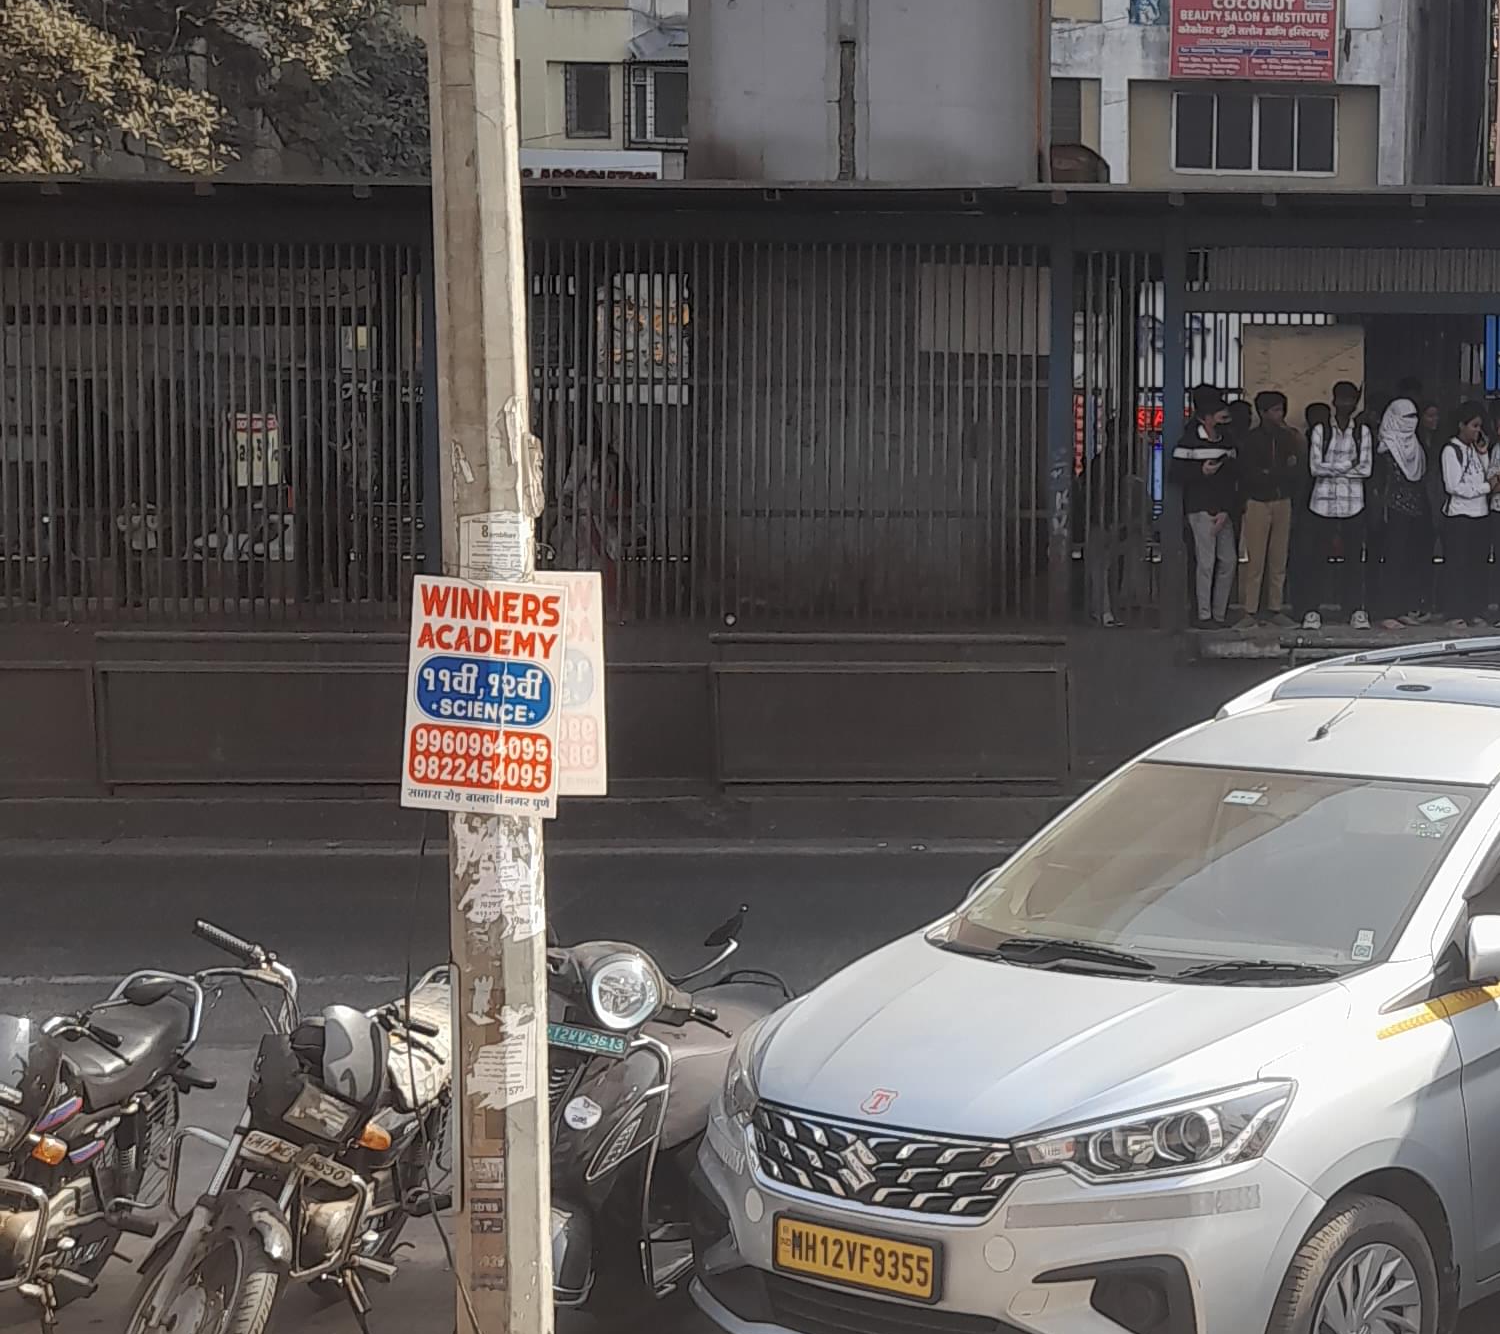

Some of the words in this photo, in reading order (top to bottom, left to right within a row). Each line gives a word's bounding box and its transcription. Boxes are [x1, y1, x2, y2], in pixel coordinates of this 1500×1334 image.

[1180, 10, 1222, 21] BEAUTY
[1224, 11, 1260, 22] SALON
[1272, 12, 1328, 23] INSTITUTE
[420, 584, 561, 627] WINNERS
[417, 623, 558, 659] ACADEMY
[439, 698, 528, 723] SCIENCE
[415, 728, 549, 763] 9960984095
[413, 754, 547, 789] 9822454095
[1426, 803, 1452, 814] CNG
[791, 1227, 930, 1288] MH12VF9355
